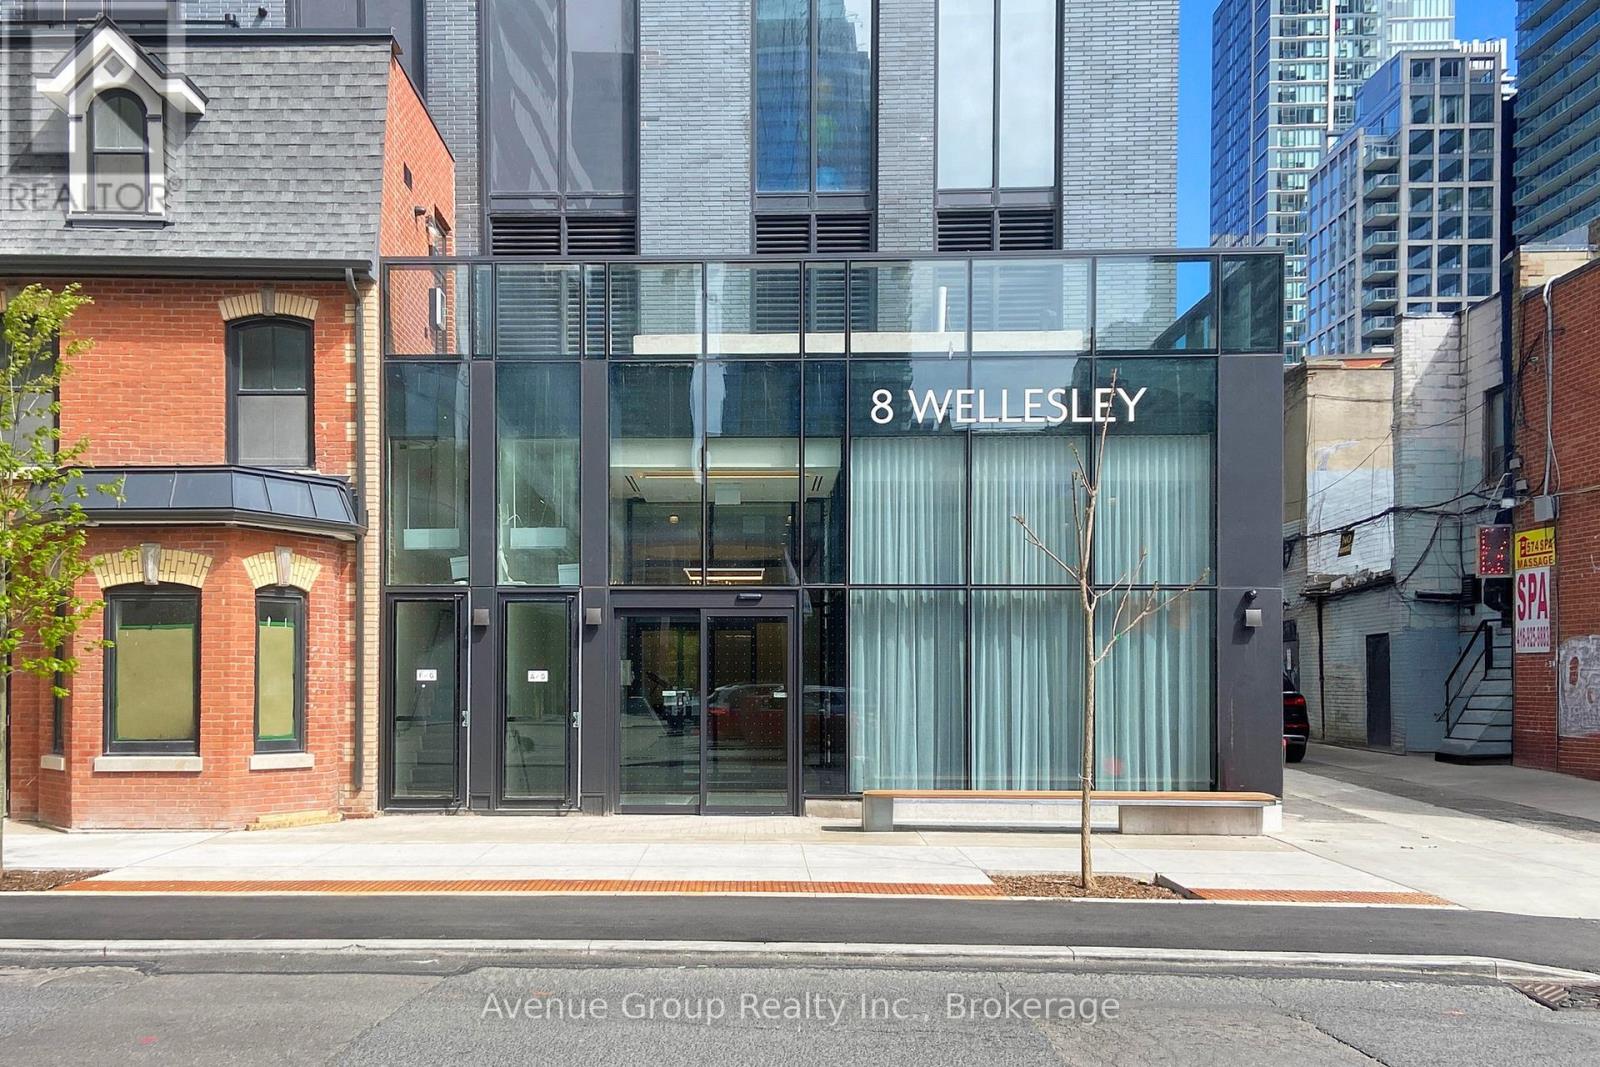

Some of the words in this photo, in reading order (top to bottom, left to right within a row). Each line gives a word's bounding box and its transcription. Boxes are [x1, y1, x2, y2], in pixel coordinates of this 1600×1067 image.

[870, 388, 894, 425] 8
[908, 387, 1148, 424] WELLESLEY
[1517, 555, 1553, 569] MASSAGE
[1517, 572, 1548, 621] SPA
